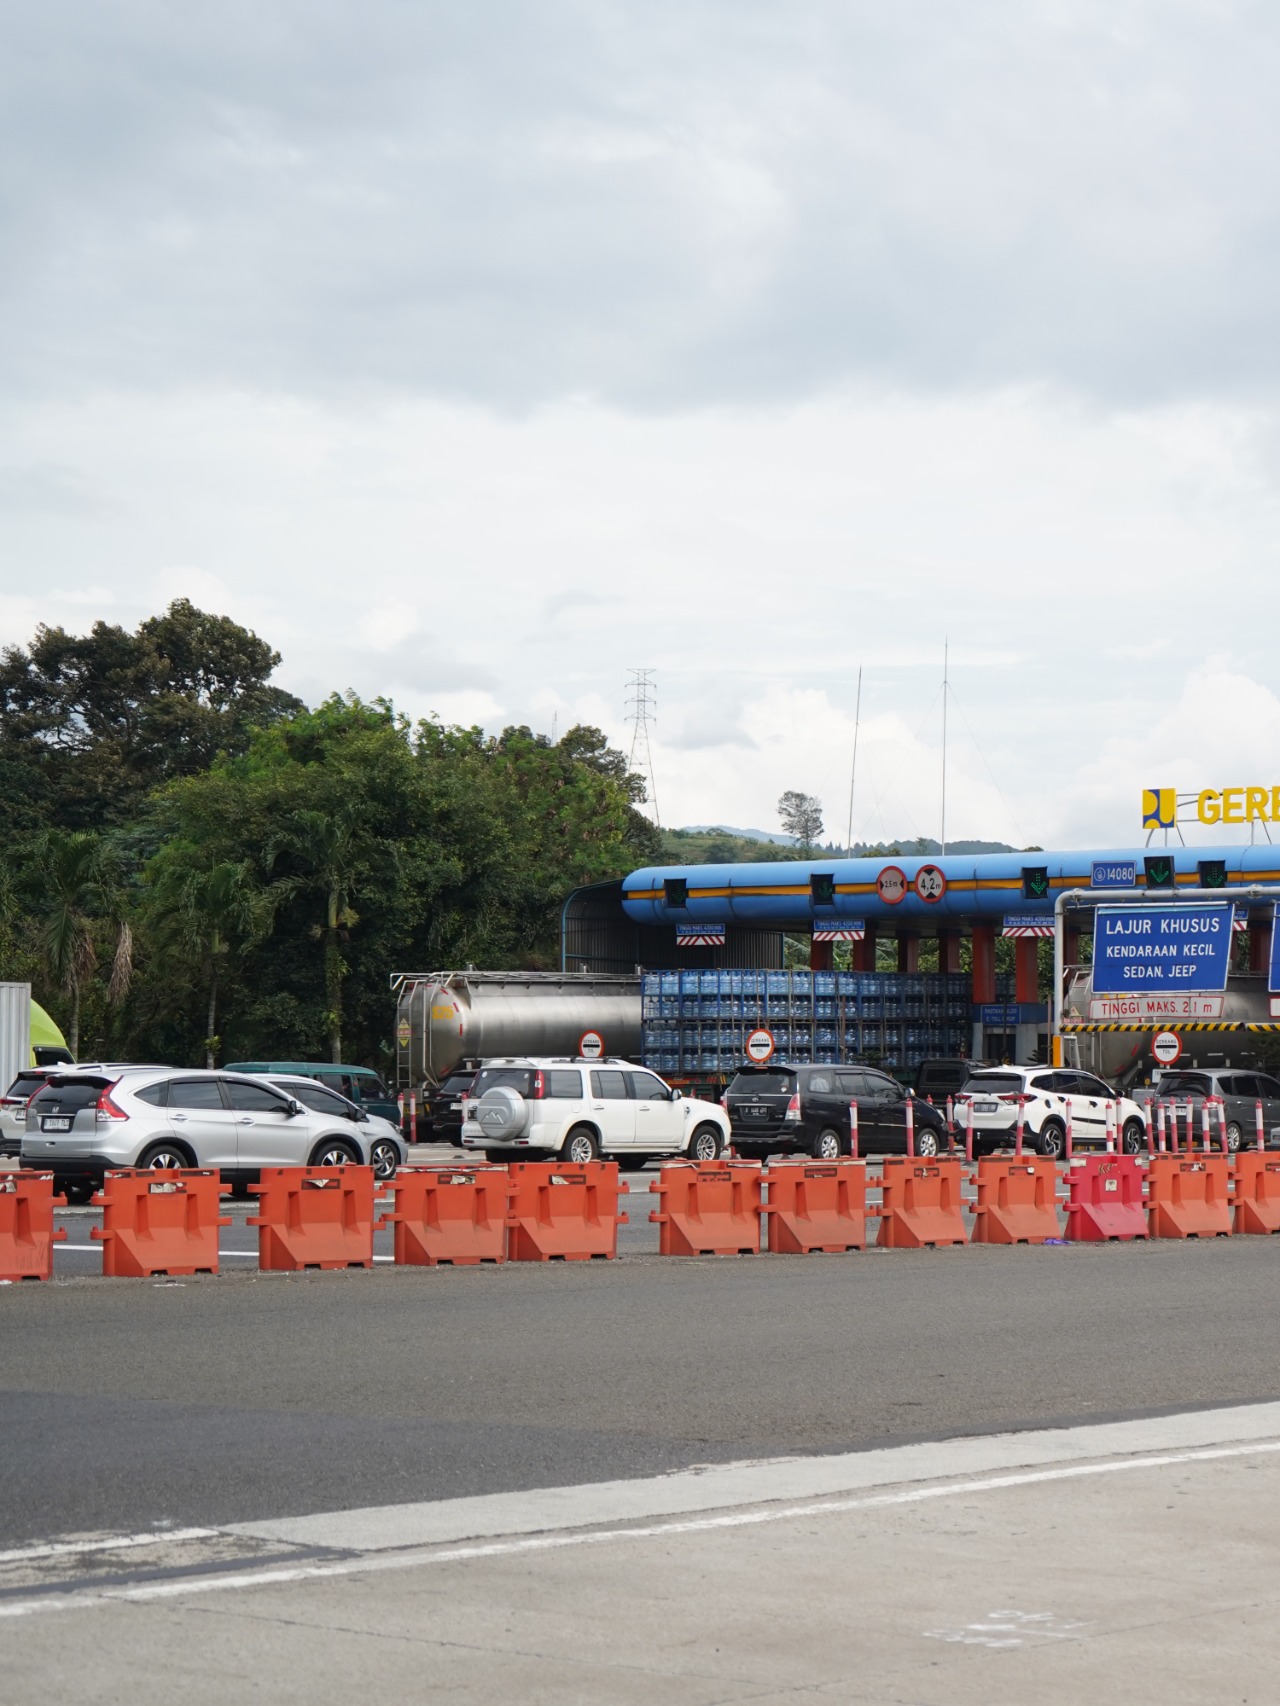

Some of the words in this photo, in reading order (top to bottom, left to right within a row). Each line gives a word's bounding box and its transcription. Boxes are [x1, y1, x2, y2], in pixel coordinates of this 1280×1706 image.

[1107, 867, 1134, 880] 14080
[1106, 919, 1152, 935] LAJUR
[1160, 917, 1220, 934] KHUSUS
[1106, 945, 1177, 958] KENDARAAN
[1183, 944, 1215, 956] KECIL
[1123, 966, 1164, 978] SEDAN,
[1168, 965, 1197, 977] JEEP
[1101, 1002, 1140, 1015] TINGGI
[1146, 1001, 1178, 1014] MAKS.
[1203, 1003, 1212, 1013] m
